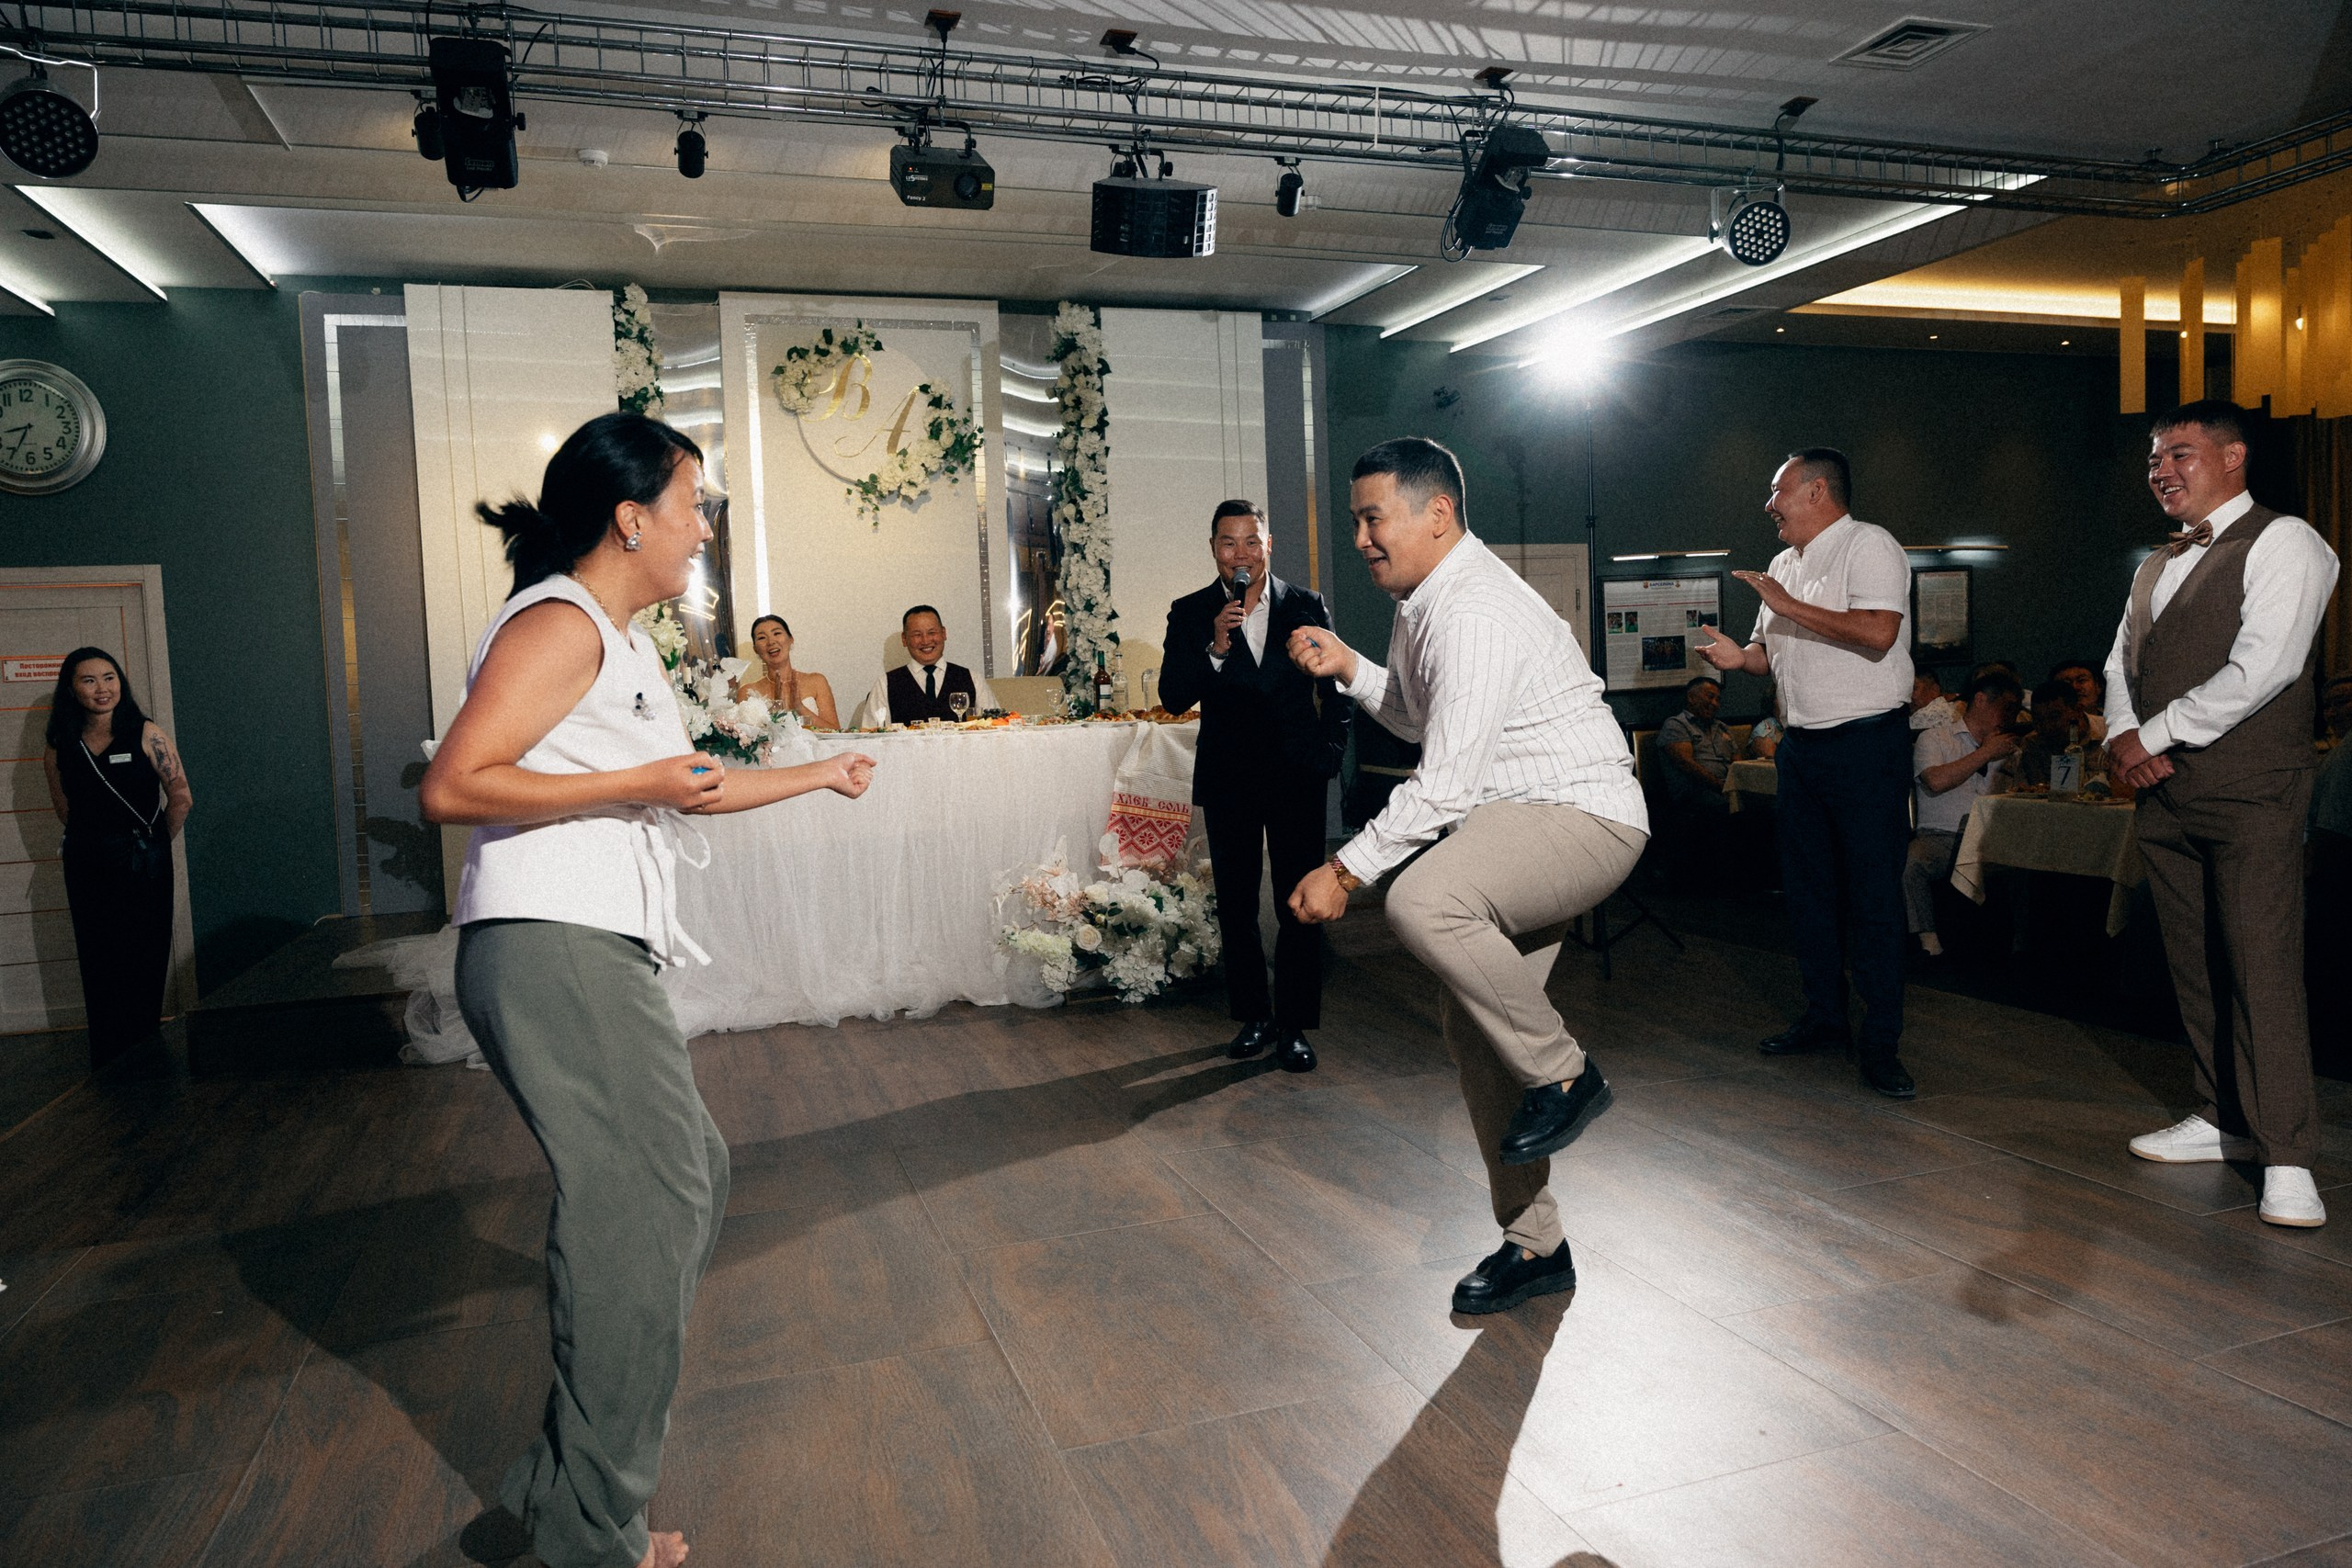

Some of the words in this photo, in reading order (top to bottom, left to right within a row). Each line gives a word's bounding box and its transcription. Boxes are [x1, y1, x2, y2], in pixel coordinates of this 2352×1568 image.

[19, 389, 34, 402] 12
[45, 393, 50, 407] 1
[55, 405, 66, 419] 2
[62, 421, 72, 434] 3
[56, 436, 66, 450] 4
[6, 446, 17, 460] 7
[26, 451, 36, 465] 6
[43, 446, 53, 460] 5
[2058, 765, 2071, 785] 7
[1116, 794, 1148, 807] ХЛЕБ
[1158, 801, 1189, 813] СОЛЬ
